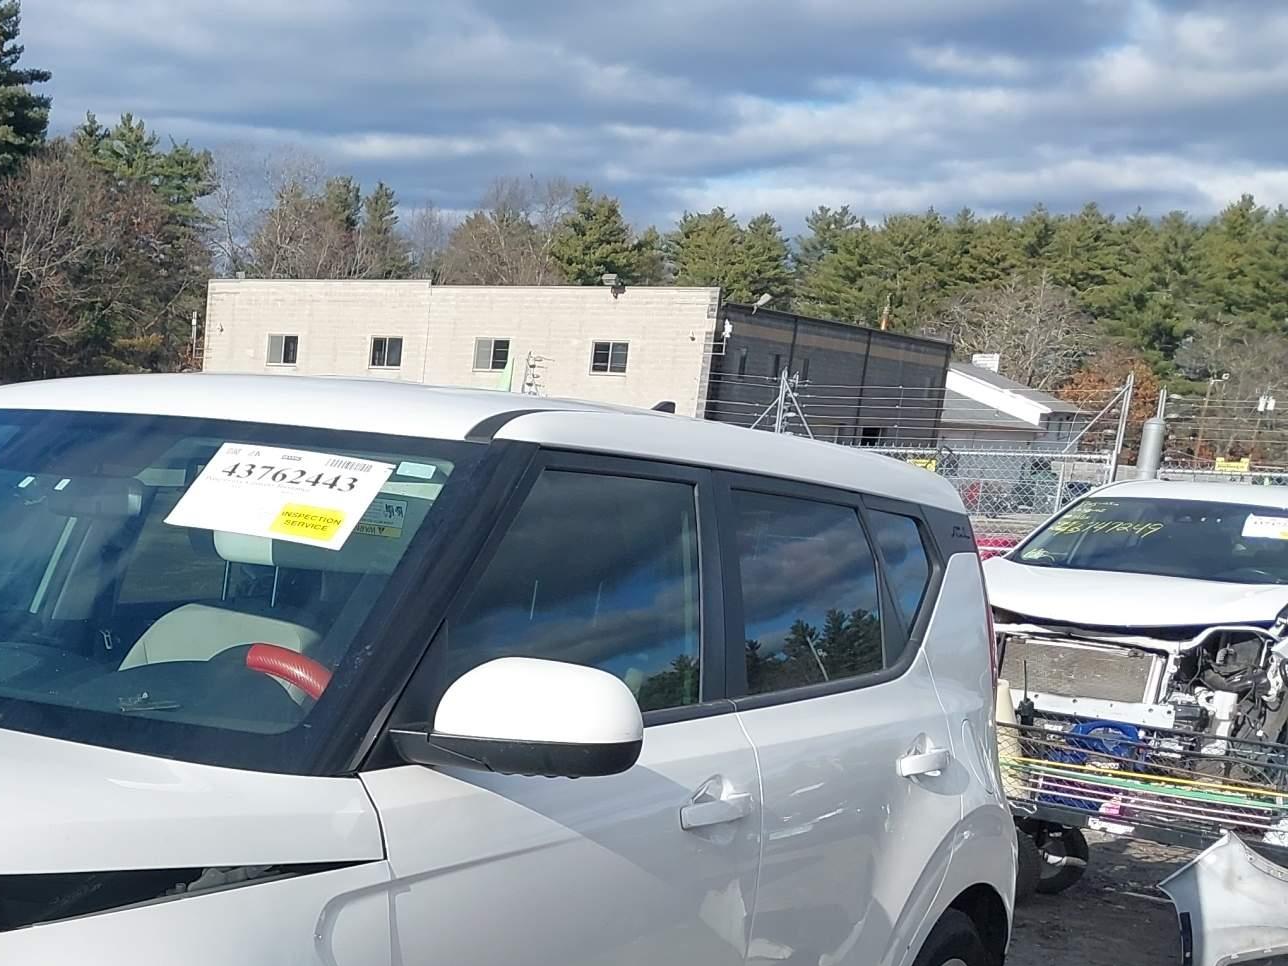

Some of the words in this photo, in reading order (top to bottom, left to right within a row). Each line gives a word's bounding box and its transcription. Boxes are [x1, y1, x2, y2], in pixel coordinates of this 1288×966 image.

[222, 462, 358, 493] 43762443
[281, 510, 342, 526] INSPECTION
[283, 519, 329, 532] SERVICE
